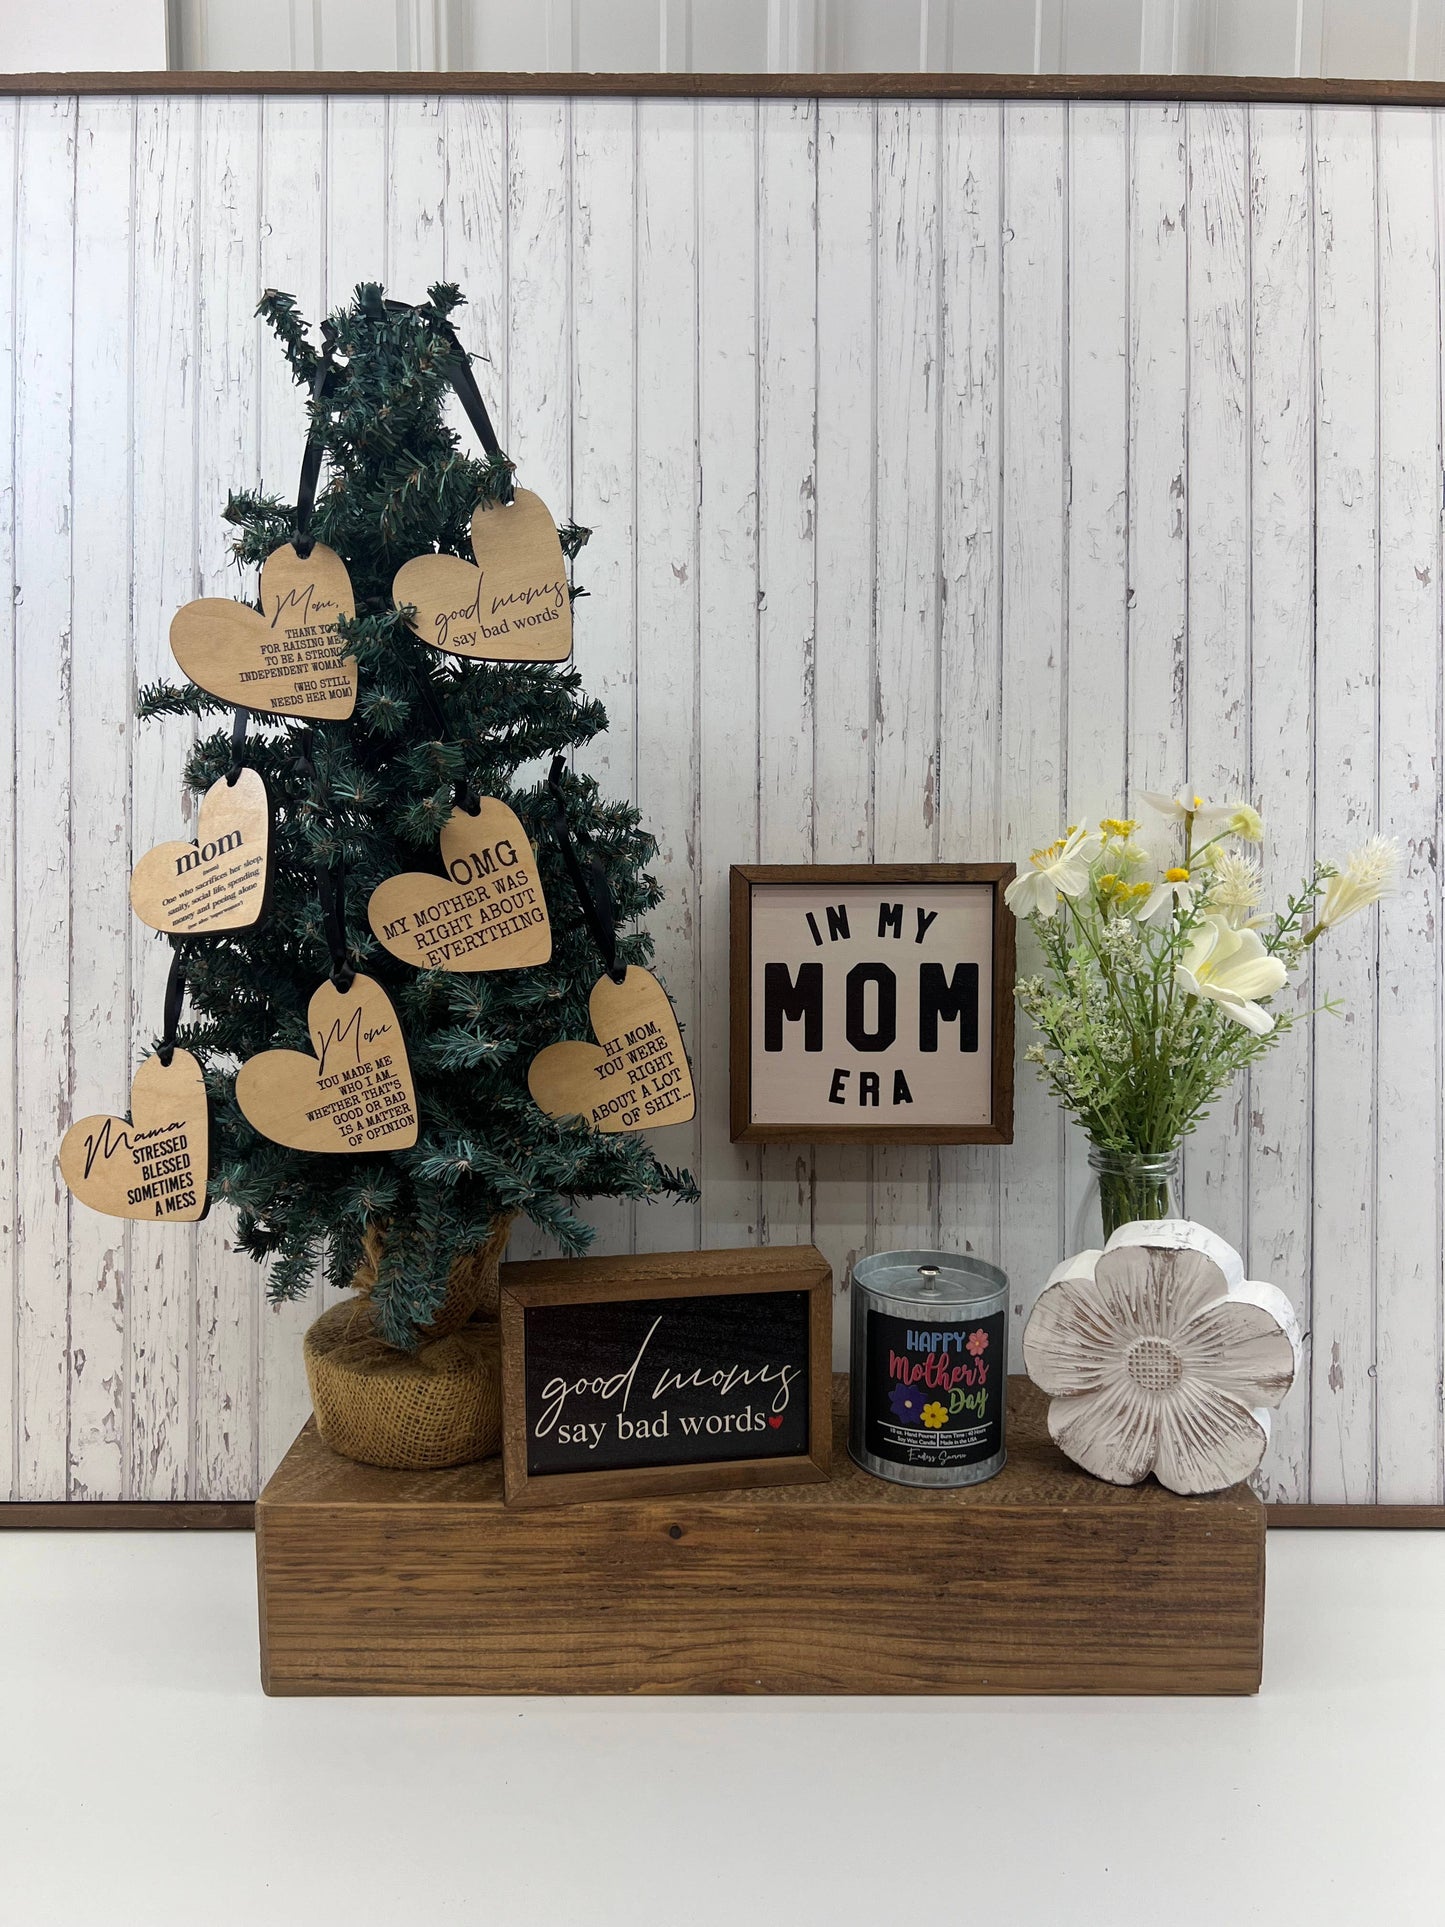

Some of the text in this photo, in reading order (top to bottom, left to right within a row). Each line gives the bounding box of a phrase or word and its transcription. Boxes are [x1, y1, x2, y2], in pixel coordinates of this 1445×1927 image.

[435, 571, 566, 645] good moms
[453, 608, 559, 647] say bad words
[260, 642, 281, 654] FOR
[283, 637, 324, 651] RAISING
[285, 625, 317, 639] THANK
[239, 658, 347, 683] INDEPENDENT WOMAN.
[264, 656, 278, 667] TO
[281, 652, 295, 664] BE
[297, 651, 304, 661] A
[270, 687, 353, 708] NEEDS HER MOM)
[294, 675, 350, 693] (WHO STILL
[175, 830, 244, 876] mom
[450, 840, 519, 885] OMG
[162, 856, 263, 906] One who sacrifices her sleep,
[168, 869, 260, 916] sanity, social life, spending
[172, 882, 258, 926] money and peeing alone
[382, 870, 529, 940] MY MOTHER WAS
[413, 888, 537, 950] RIGHT ABOUT
[426, 907, 545, 967] EVERYTHING
[805, 902, 938, 946] IN MY
[764, 962, 979, 1052] MOM
[318, 1007, 392, 1076] Mom
[594, 1036, 668, 1080] YOU WERE
[601, 1021, 661, 1057] HI MOM,
[316, 1055, 393, 1091] YOU MADE ME
[339, 1081, 363, 1096] WHO
[366, 1077, 373, 1087] I
[626, 1052, 675, 1085] RIGHT
[828, 1068, 913, 1107] ERA
[305, 1079, 402, 1122] WHETHER THAT'S
[333, 1091, 406, 1125] GOOD OR BAD
[591, 1068, 682, 1123] ABOUT A LOT
[338, 1103, 411, 1137] IS A MATTER
[348, 1114, 415, 1146] OF OPINION
[622, 1107, 641, 1126] OF
[84, 1118, 186, 1180] Mama
[132, 1134, 187, 1164] STRESSED
[142, 1153, 190, 1181] BLESSED
[127, 1172, 193, 1205] SOMETIMES
[155, 1191, 196, 1216] A MESS
[906, 1329, 966, 1352] HAPPY
[535, 1315, 801, 1438] good moms
[889, 1350, 990, 1391] Mother's
[948, 1387, 989, 1419] Day
[557, 1405, 766, 1449] say bad words
